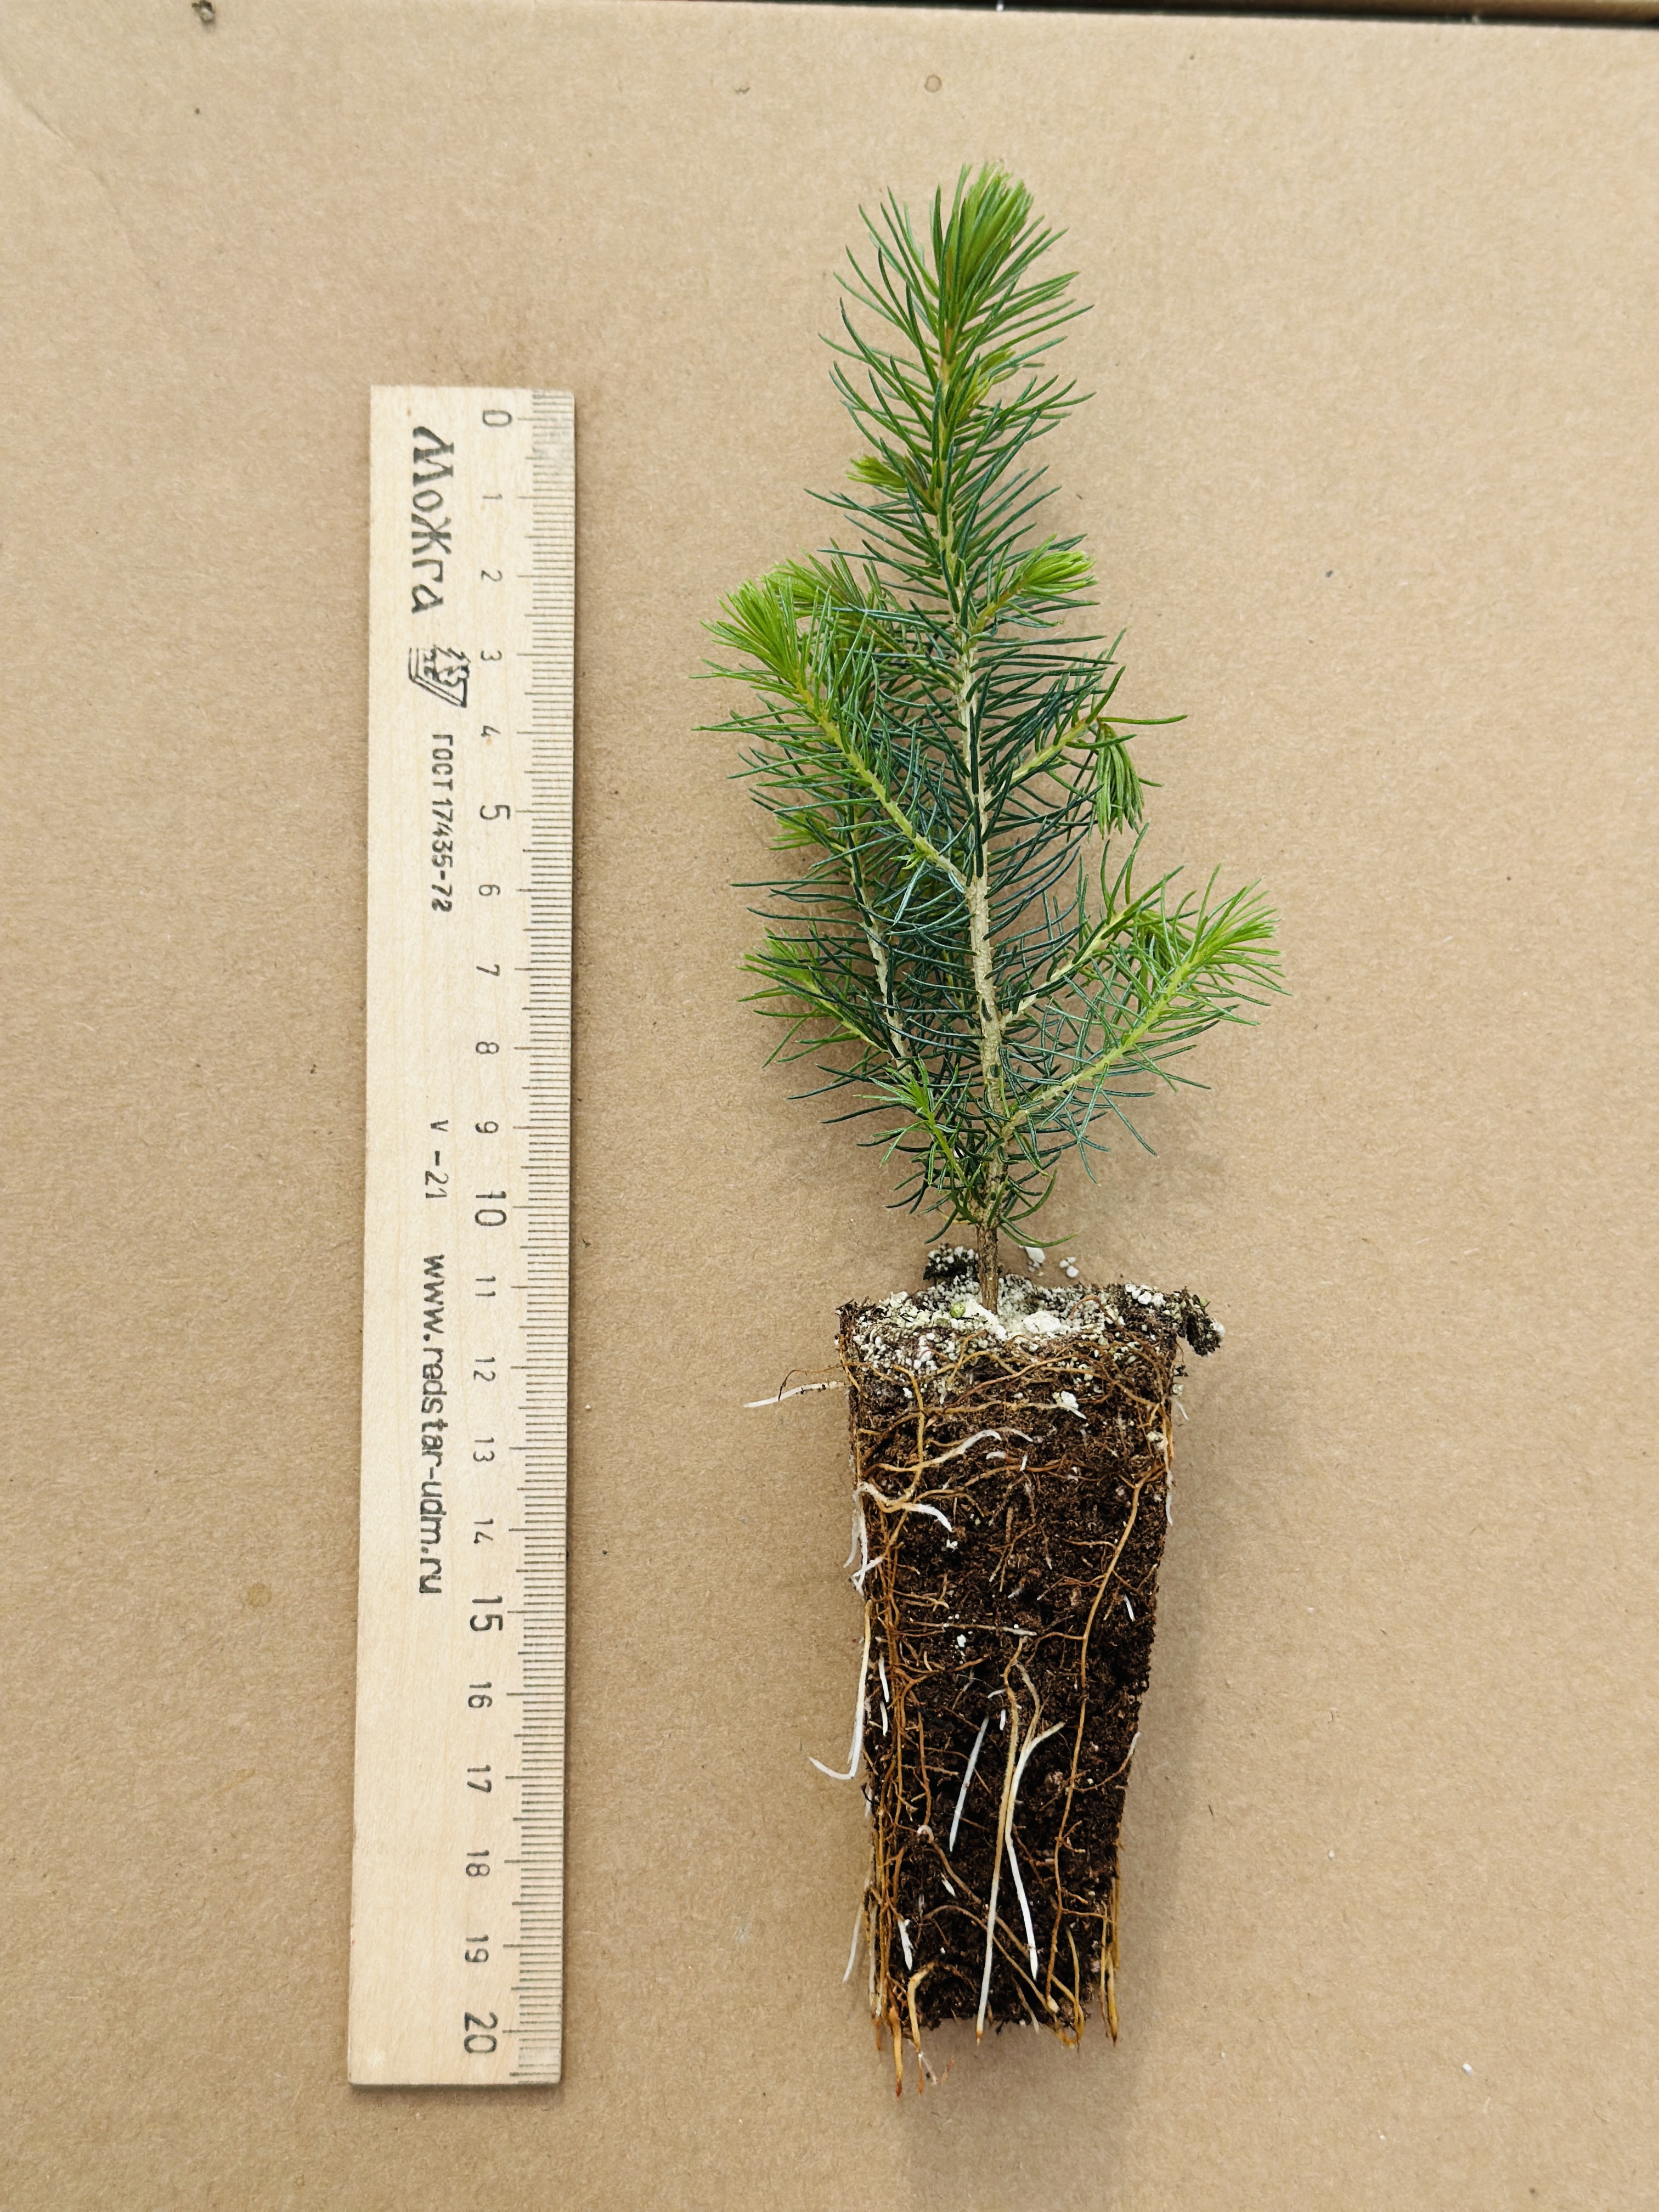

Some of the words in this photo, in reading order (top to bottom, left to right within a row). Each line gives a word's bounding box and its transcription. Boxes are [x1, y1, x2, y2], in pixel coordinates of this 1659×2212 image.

[482, 409, 512, 427] 0
[481, 569, 503, 582] 2
[481, 650, 502, 662] 3
[481, 725, 501, 737] 4
[432, 733, 453, 791] ГОСТ
[479, 804, 511, 820] 5
[431, 798, 453, 912] 17435-72
[478, 884, 501, 896] 6
[476, 964, 500, 977] 7
[475, 1041, 500, 1054] 8
[475, 1121, 499, 1133] 9
[475, 1190, 507, 1227] 10
[475, 1276, 496, 1297] 11
[473, 1356, 496, 1381] 12
[419, 1254, 448, 1594] www.redstar-udm.ru
[472, 1437, 495, 1462] 13
[473, 1518, 494, 1544] 14
[469, 1595, 504, 1632] 15
[467, 1681, 493, 1708] 16
[466, 1764, 492, 1793] 17
[465, 1849, 490, 1877] 18
[464, 1934, 489, 1963] 19
[464, 2012, 498, 2054] 20
